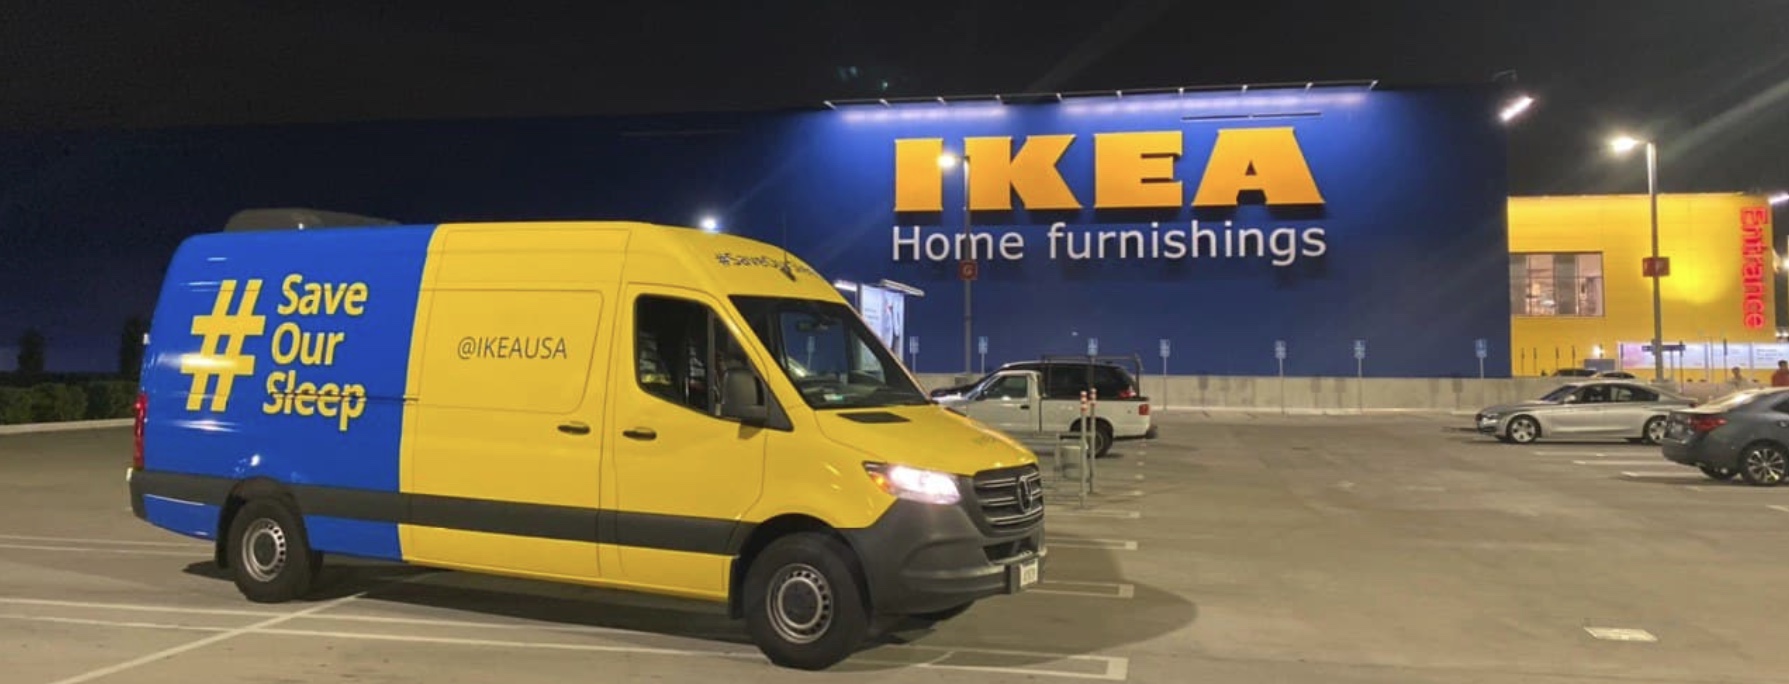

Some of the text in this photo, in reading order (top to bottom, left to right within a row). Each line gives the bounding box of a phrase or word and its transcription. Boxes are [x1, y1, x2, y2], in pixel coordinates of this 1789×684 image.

[894, 127, 1326, 211] IKEA
[892, 220, 1328, 267] Home furnishings
[1741, 207, 1768, 329] Entrance
[277, 273, 368, 316] Save
[271, 321, 345, 366] Our
[457, 335, 568, 360] @IKEAUSA
[262, 369, 366, 432] Sleep
